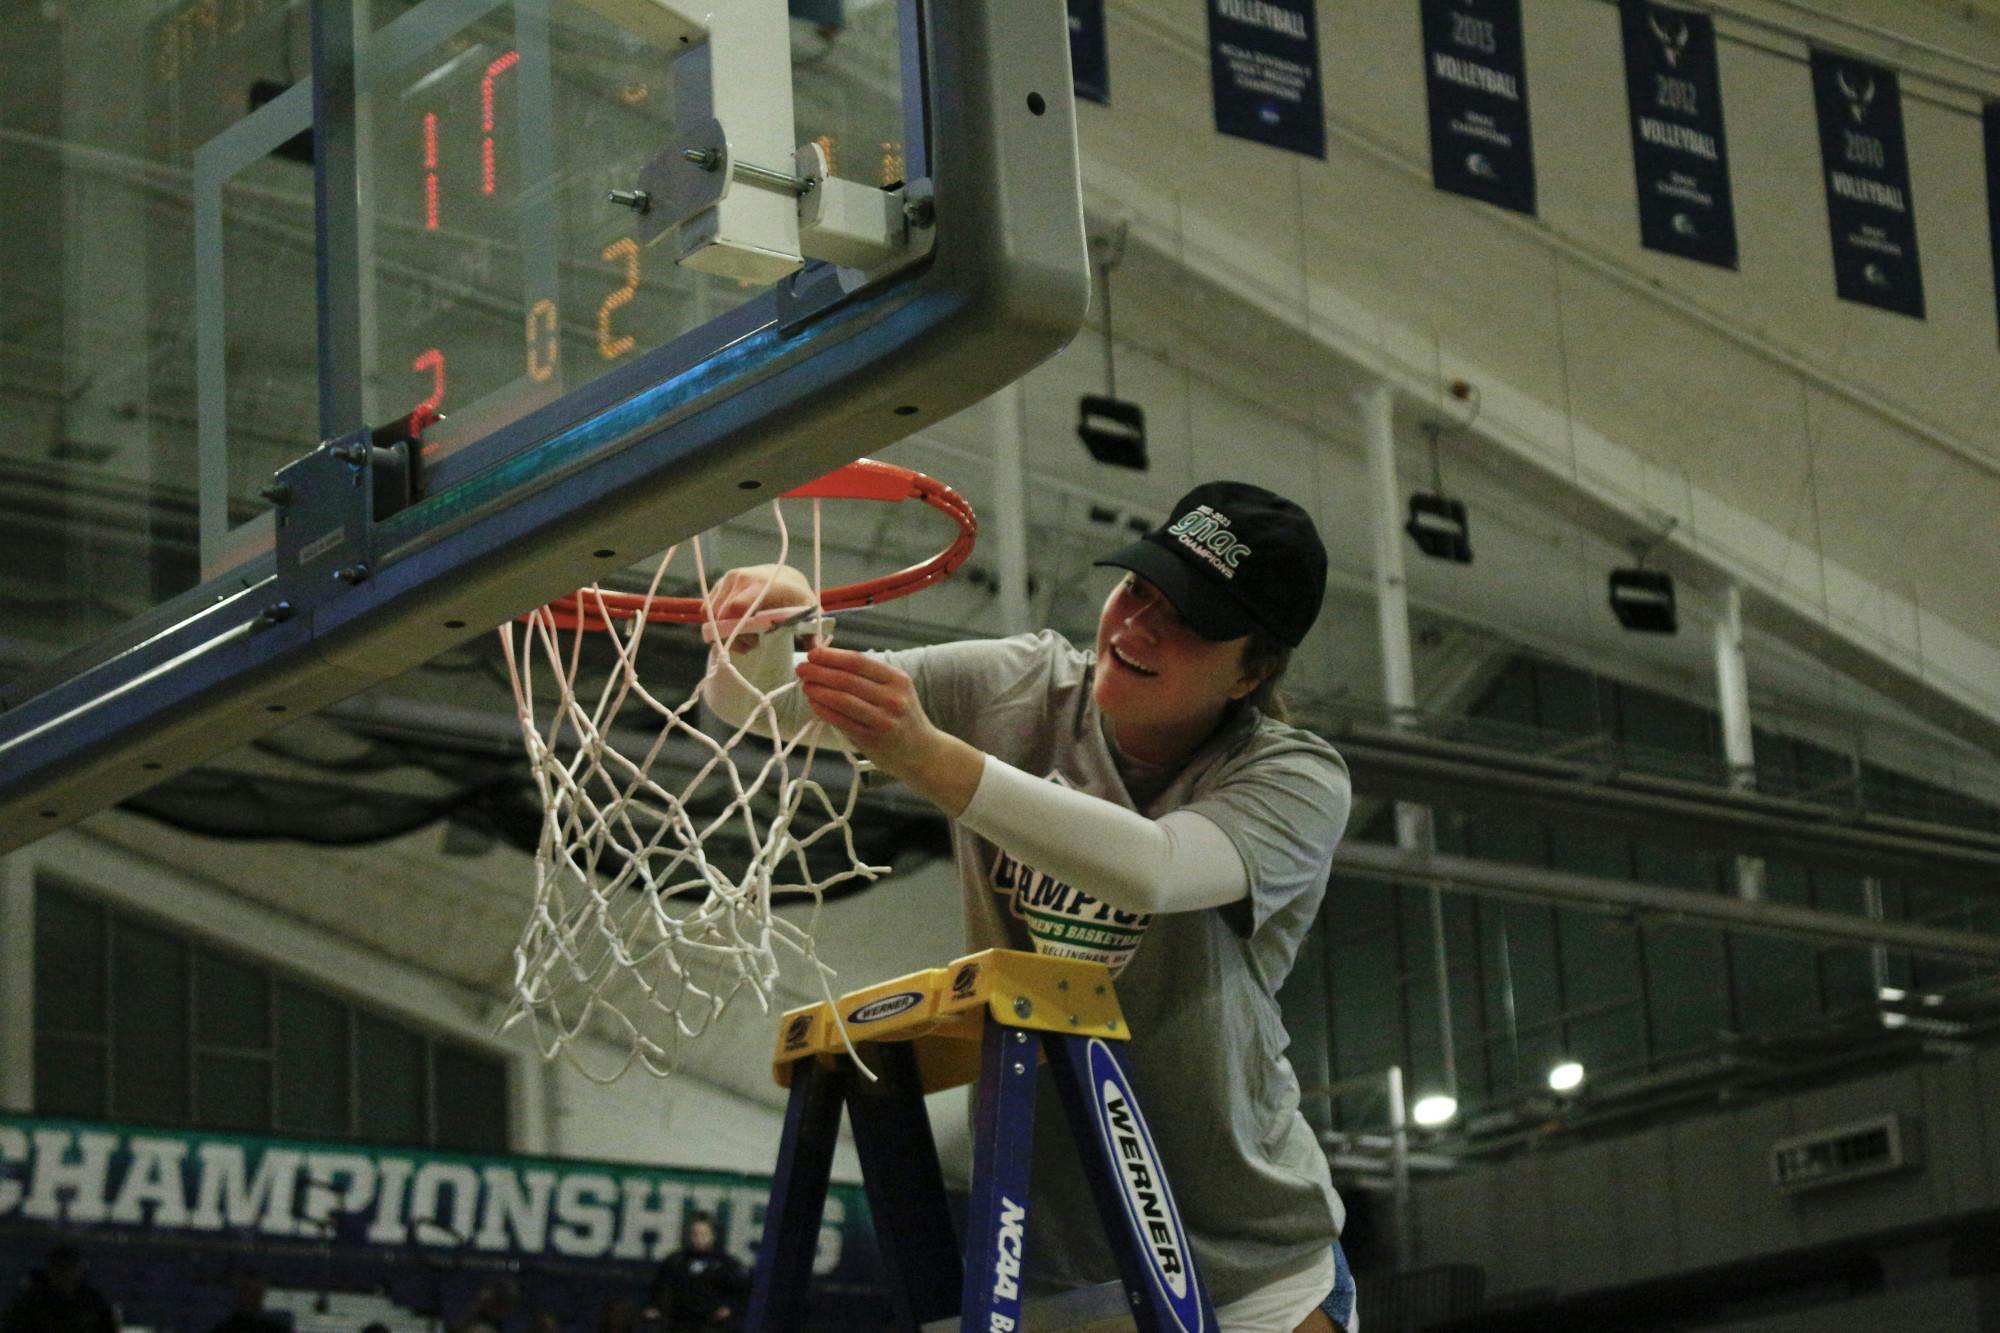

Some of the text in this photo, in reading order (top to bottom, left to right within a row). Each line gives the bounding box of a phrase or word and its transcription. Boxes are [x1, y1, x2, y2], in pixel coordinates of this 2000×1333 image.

[1217, 0, 1307, 39] VOLLEYBALL
[1433, 51, 1519, 100] VOLLEYBALL
[1656, 74, 1698, 117] 2012
[1639, 115, 1718, 160] VOLLEYBALL
[1831, 171, 1905, 213] VOLLEYBALL
[1178, 533, 1236, 579] CHAMPIONS
[862, 997, 910, 1019] WERNER
[1107, 1098, 1181, 1275] WERNER
[993, 1195, 1025, 1301] NCAA
